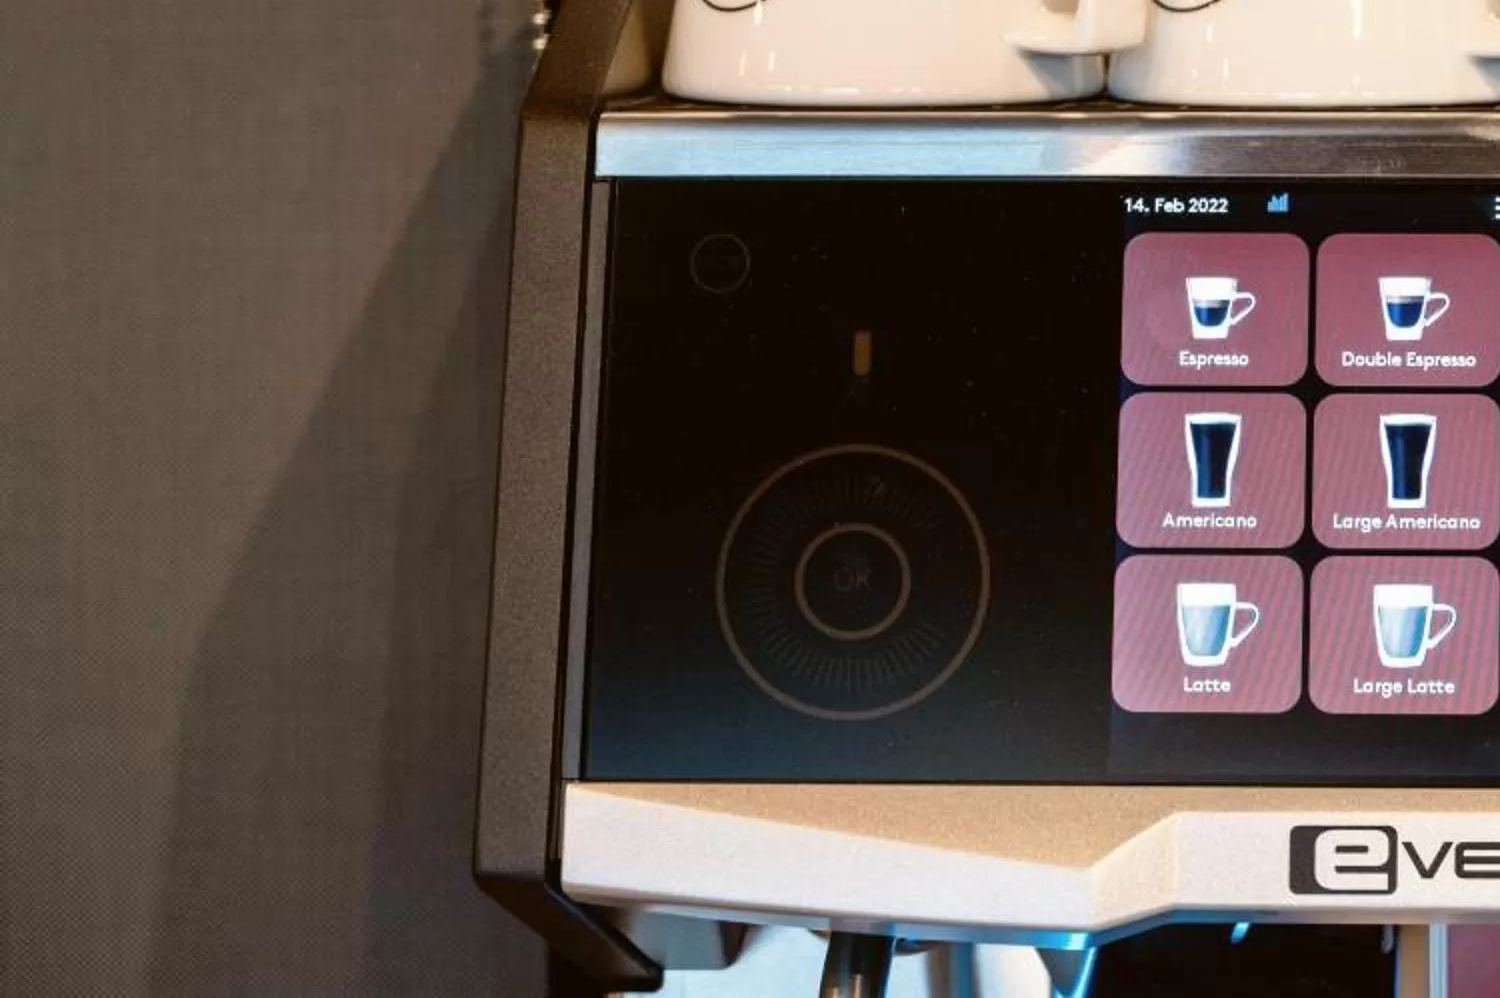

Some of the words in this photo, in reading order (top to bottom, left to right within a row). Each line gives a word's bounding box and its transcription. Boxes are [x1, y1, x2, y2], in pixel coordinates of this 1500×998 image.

[1124, 197, 1150, 214] 14.
[1154, 197, 1185, 214] Feb
[1188, 197, 1229, 214] 2022
[1179, 350, 1250, 370] Espresso
[1341, 350, 1401, 368] Double
[1406, 352, 1477, 371] Espresso
[1161, 512, 1258, 529] Americano
[1332, 513, 1382, 533] Large
[1385, 514, 1482, 531] Americano
[1183, 676, 1232, 694] Latte
[1353, 677, 1403, 698] Large
[1407, 678, 1457, 695] Latte
